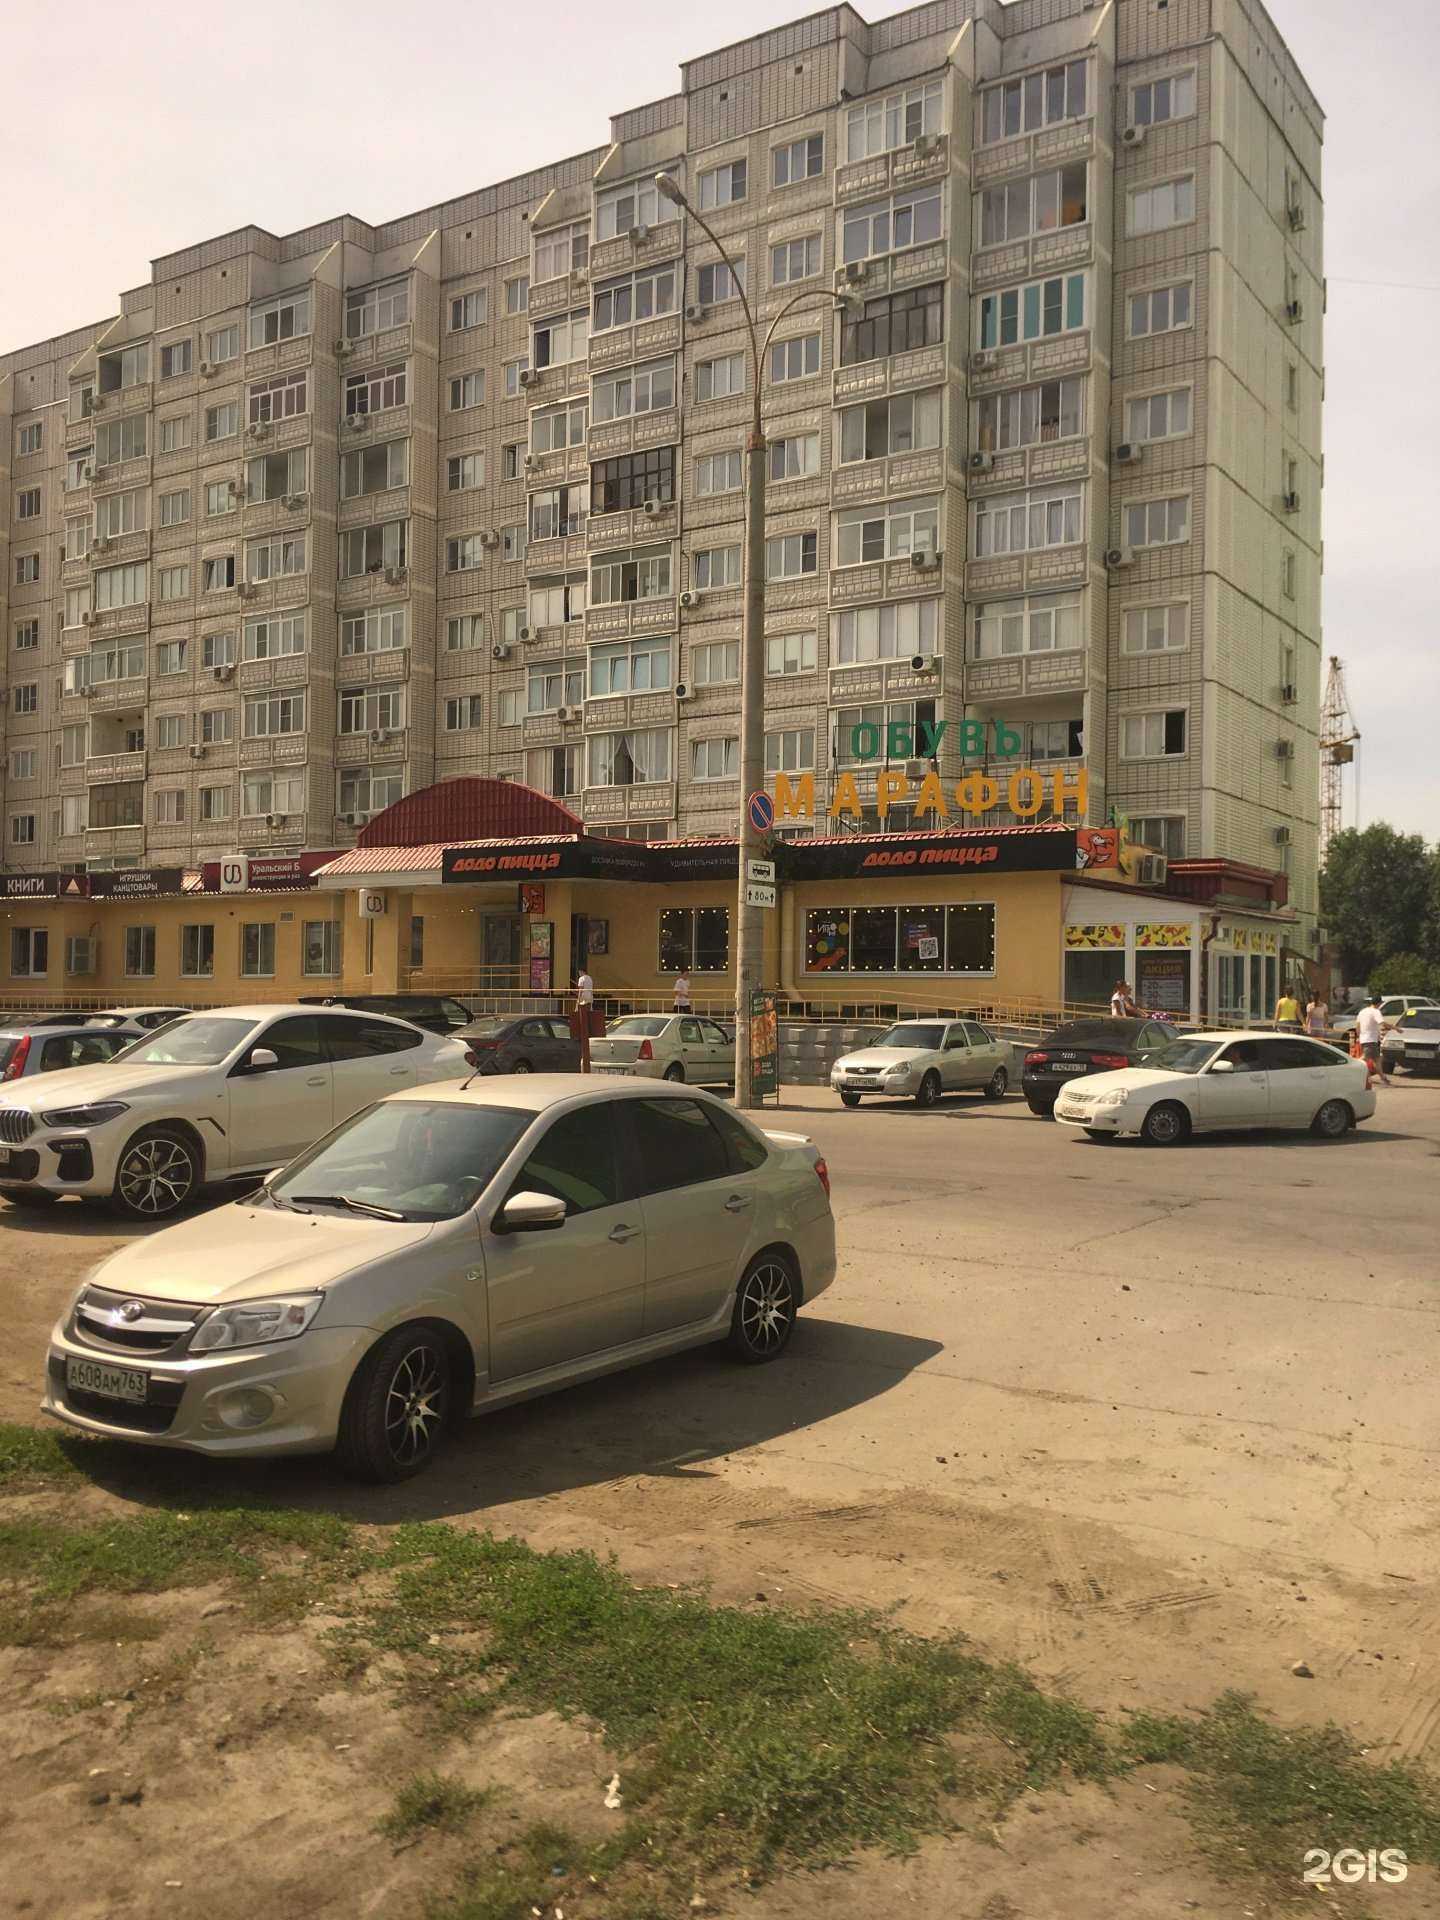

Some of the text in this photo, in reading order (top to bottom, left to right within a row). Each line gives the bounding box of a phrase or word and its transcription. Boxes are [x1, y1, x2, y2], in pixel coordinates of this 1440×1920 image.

[851, 720, 1022, 760] ОБУВЬ
[774, 768, 1088, 818] МАРАФОН
[119, 873, 151, 882] ИГРУШКИ
[7, 878, 45, 893] КНИГИ
[113, 882, 157, 893] КАНЦТОВАРЫ
